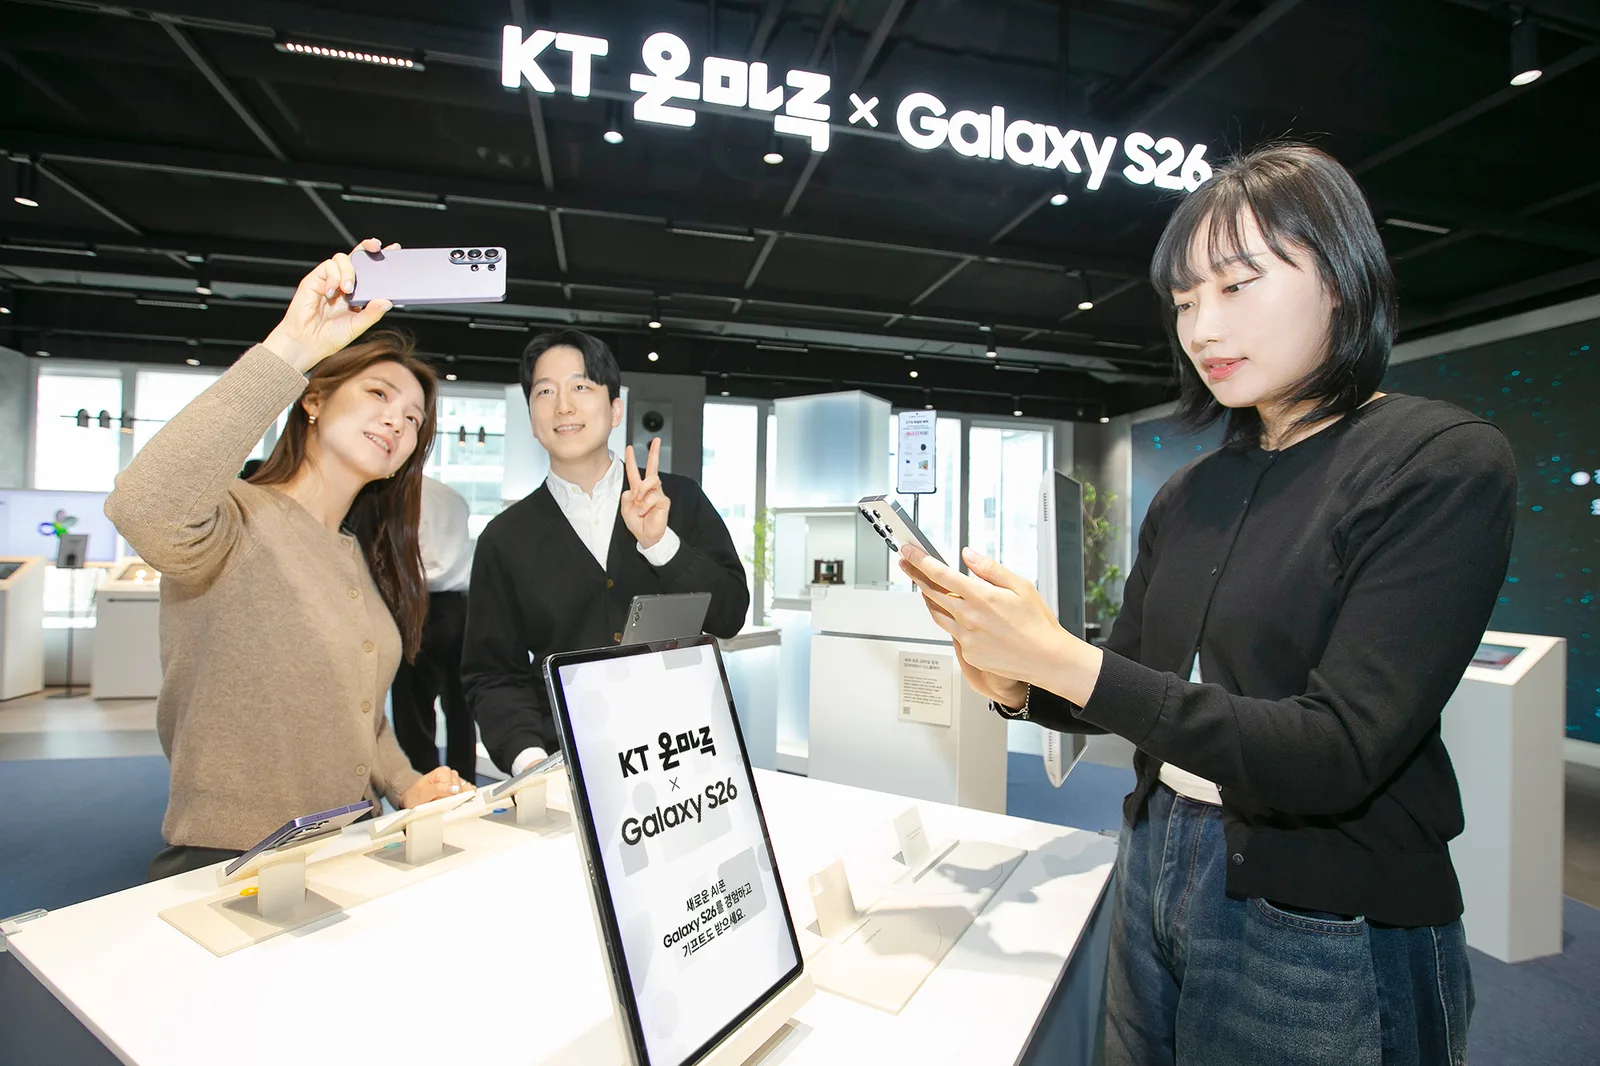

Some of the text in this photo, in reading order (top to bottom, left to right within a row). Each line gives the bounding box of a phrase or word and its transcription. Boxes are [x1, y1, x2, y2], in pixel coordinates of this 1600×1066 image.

[501, 24, 609, 98] KT
[896, 92, 1119, 191] Galaxy
[1122, 131, 1213, 193] S26
[618, 744, 649, 779] KT
[621, 776, 738, 846] Galaxy S26
[663, 882, 753, 948] Galaxy S26를 경험하고
[686, 879, 726, 912] 새로운 AI폰
[682, 908, 746, 958] 기프트도 받으세요.
